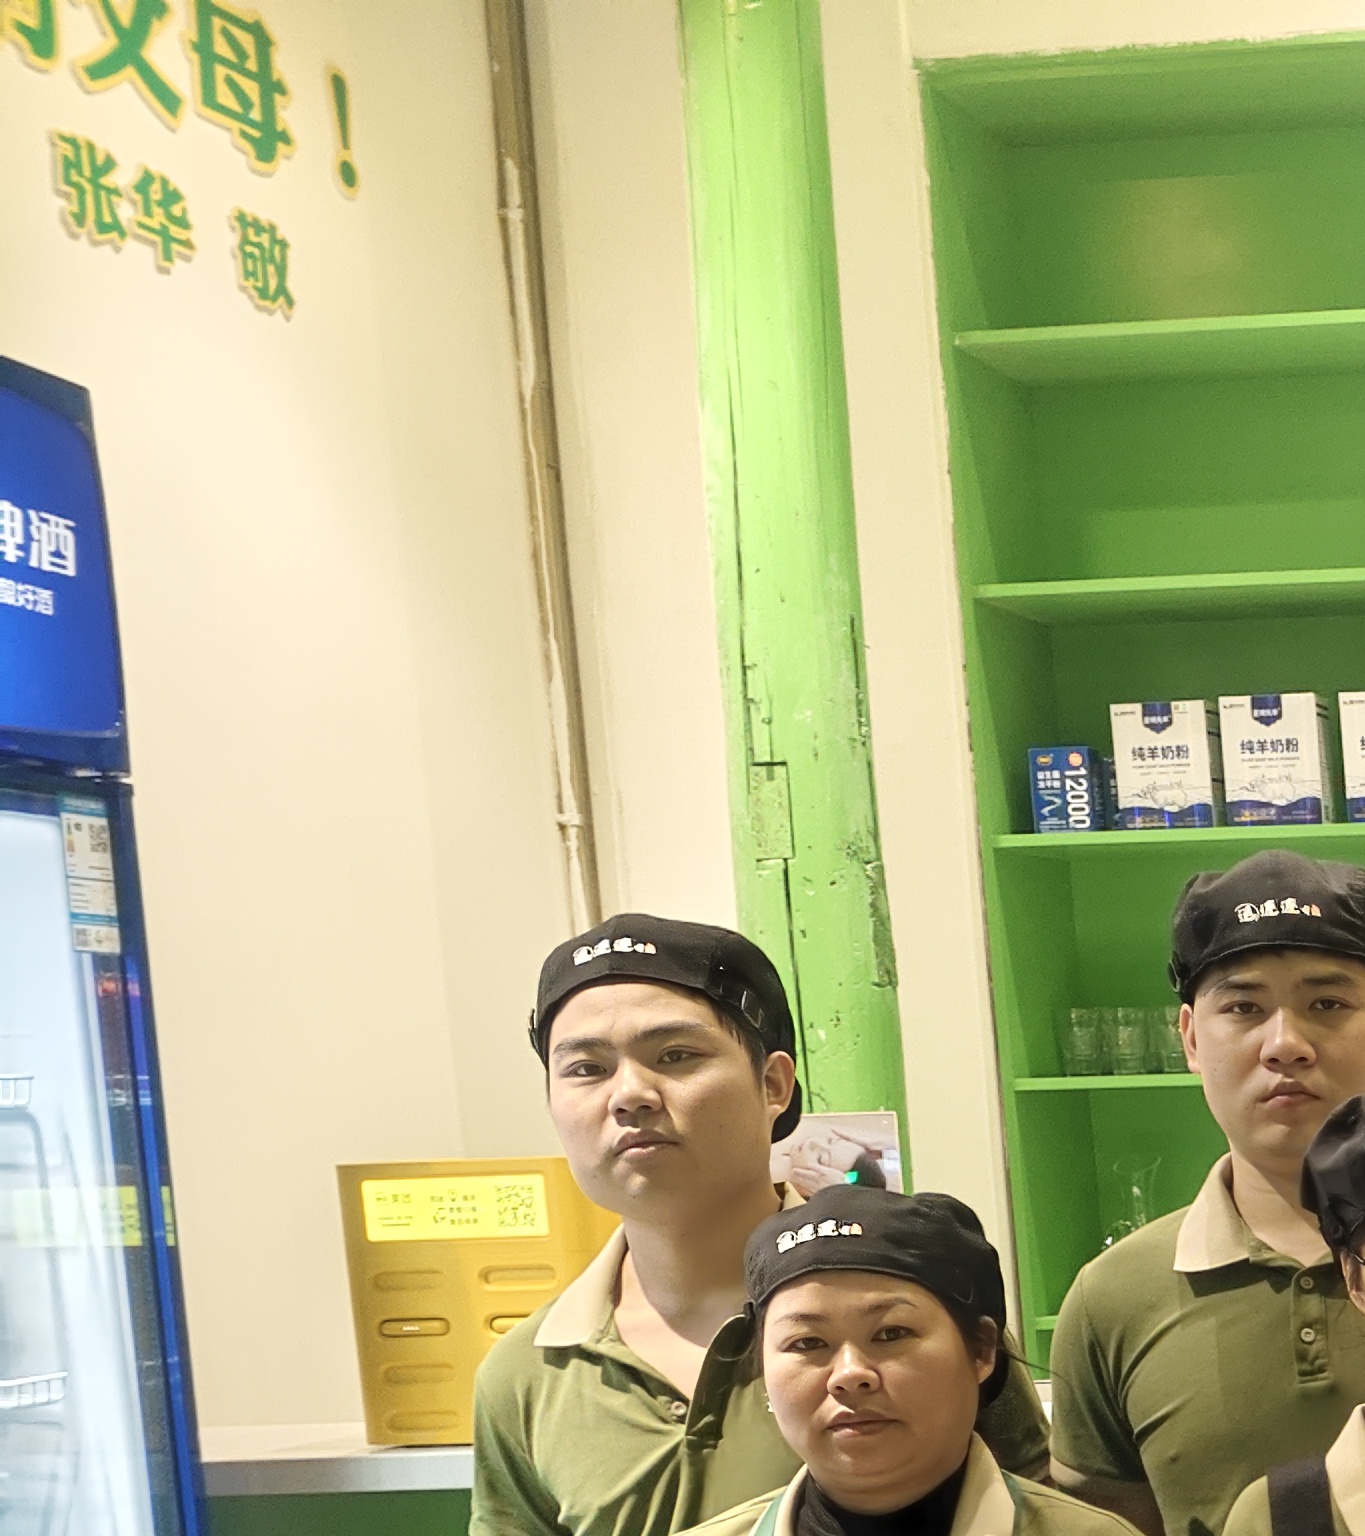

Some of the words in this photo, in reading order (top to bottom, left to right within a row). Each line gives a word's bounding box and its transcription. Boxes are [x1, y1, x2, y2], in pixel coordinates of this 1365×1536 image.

[55, 132, 196, 265] 张华
[234, 208, 295, 310] 敬
[1131, 744, 1189, 761] 纯羊奶粉
[1239, 738, 1299, 754] 纯羊奶粉
[1064, 767, 1091, 829] 12000
